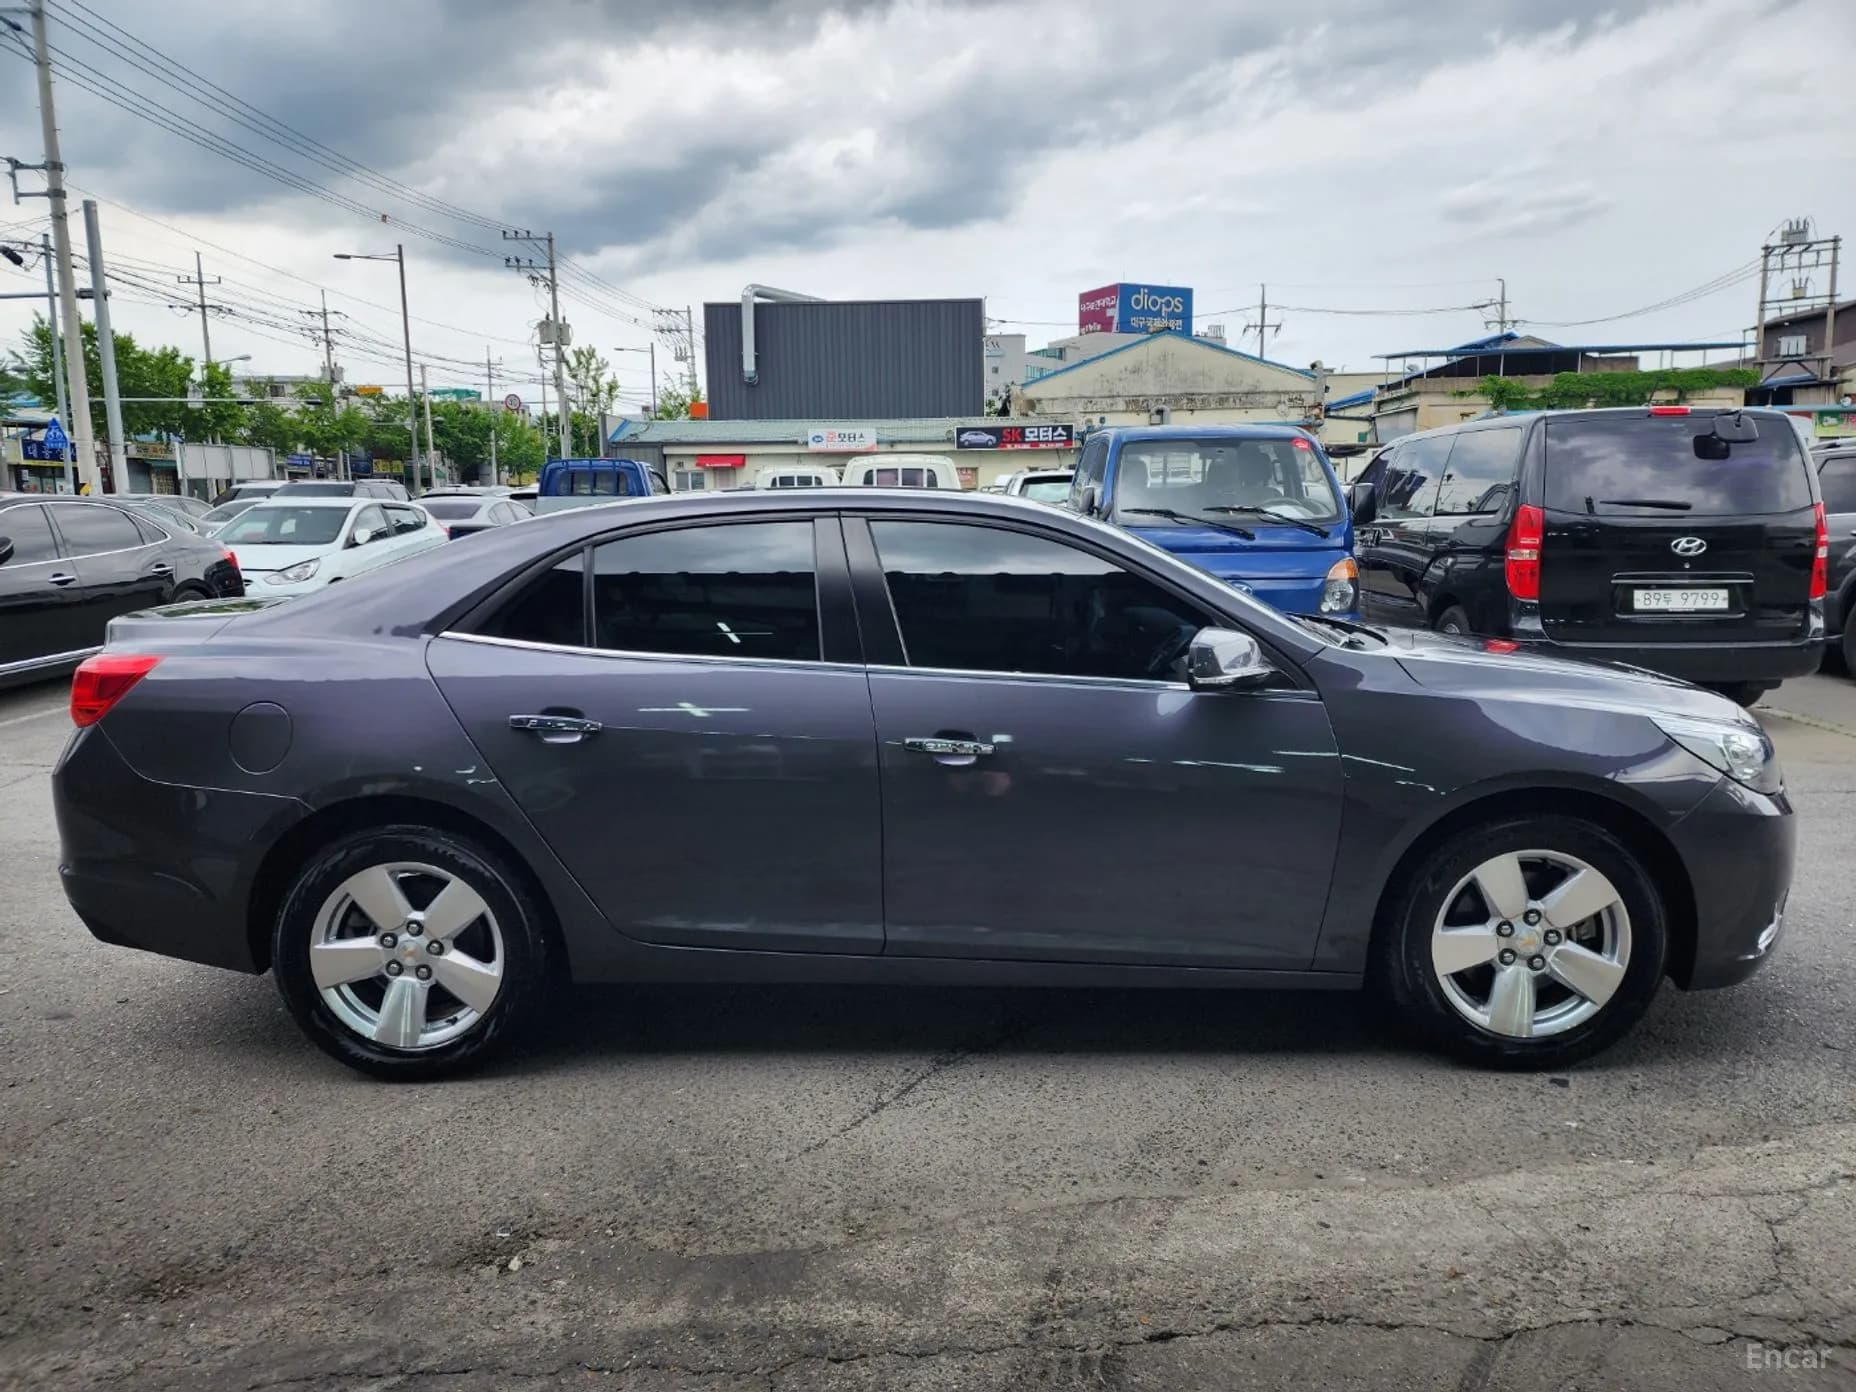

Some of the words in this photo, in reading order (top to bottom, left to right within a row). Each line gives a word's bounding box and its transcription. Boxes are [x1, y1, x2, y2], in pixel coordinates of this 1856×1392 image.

[1131, 288, 1183, 316] diops
[1002, 428, 1021, 441] SK
[1025, 427, 1067, 441] 모터스
[1680, 592, 1719, 606] 9799
